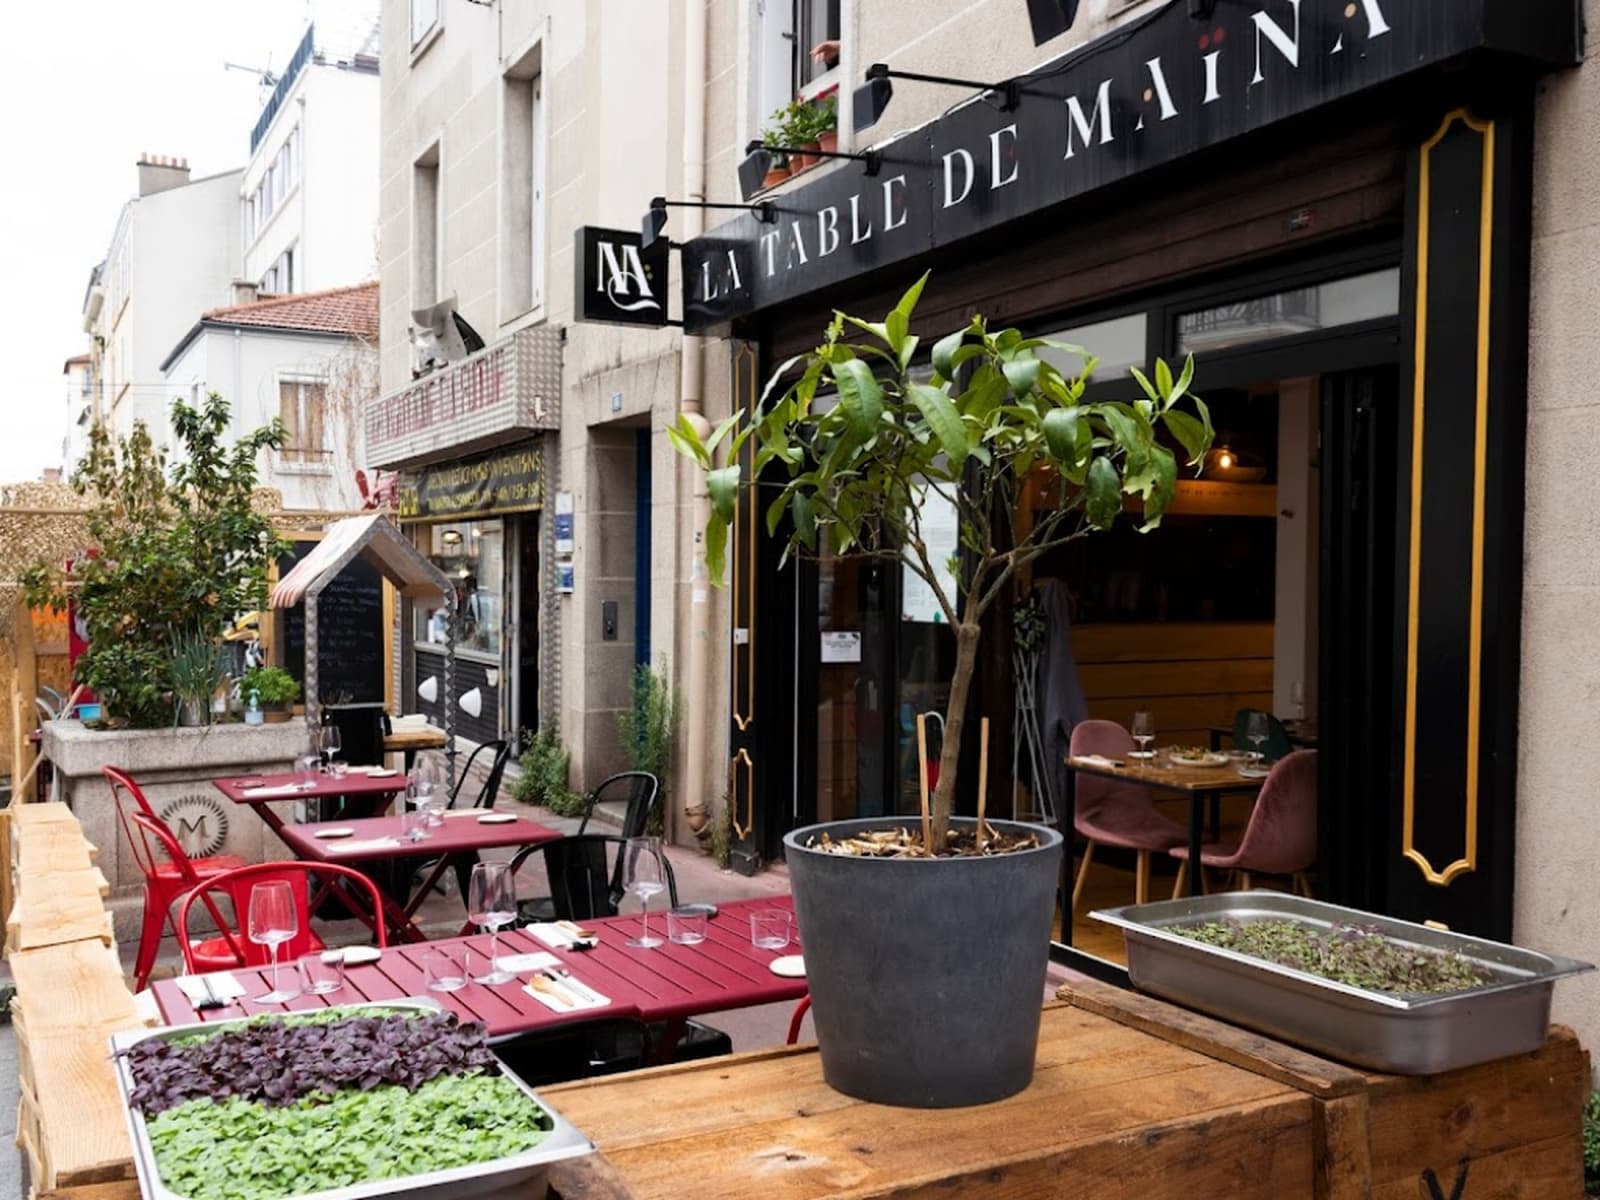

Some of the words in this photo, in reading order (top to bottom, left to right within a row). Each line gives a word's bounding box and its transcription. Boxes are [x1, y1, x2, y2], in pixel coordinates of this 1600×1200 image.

[701, 248, 741, 302] LA
[760, 175, 907, 278] TABLE
[942, 123, 1018, 208] DE
[177, 814, 211, 842] M
